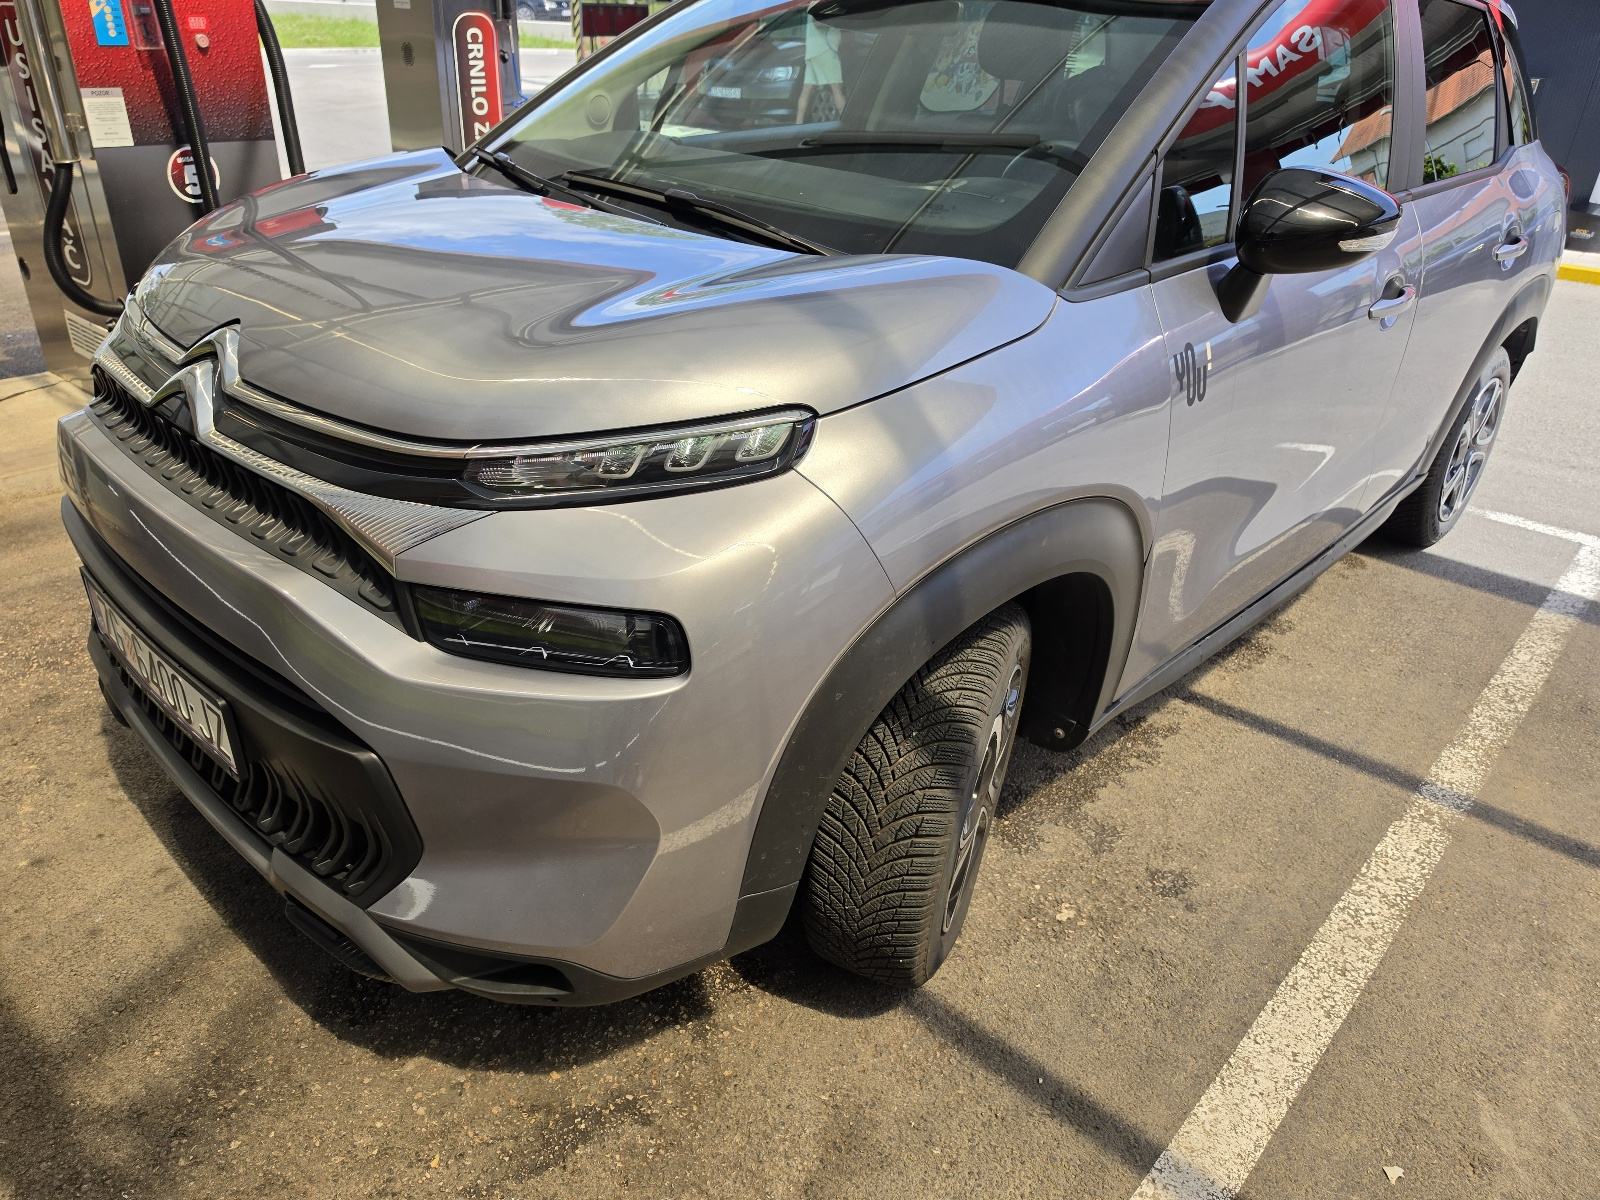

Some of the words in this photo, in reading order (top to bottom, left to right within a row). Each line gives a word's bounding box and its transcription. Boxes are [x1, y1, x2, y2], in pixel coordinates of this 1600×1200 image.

[466, 27, 489, 115] CRNILO
[5, 19, 81, 269] USISAČ
[473, 121, 491, 141] Z
